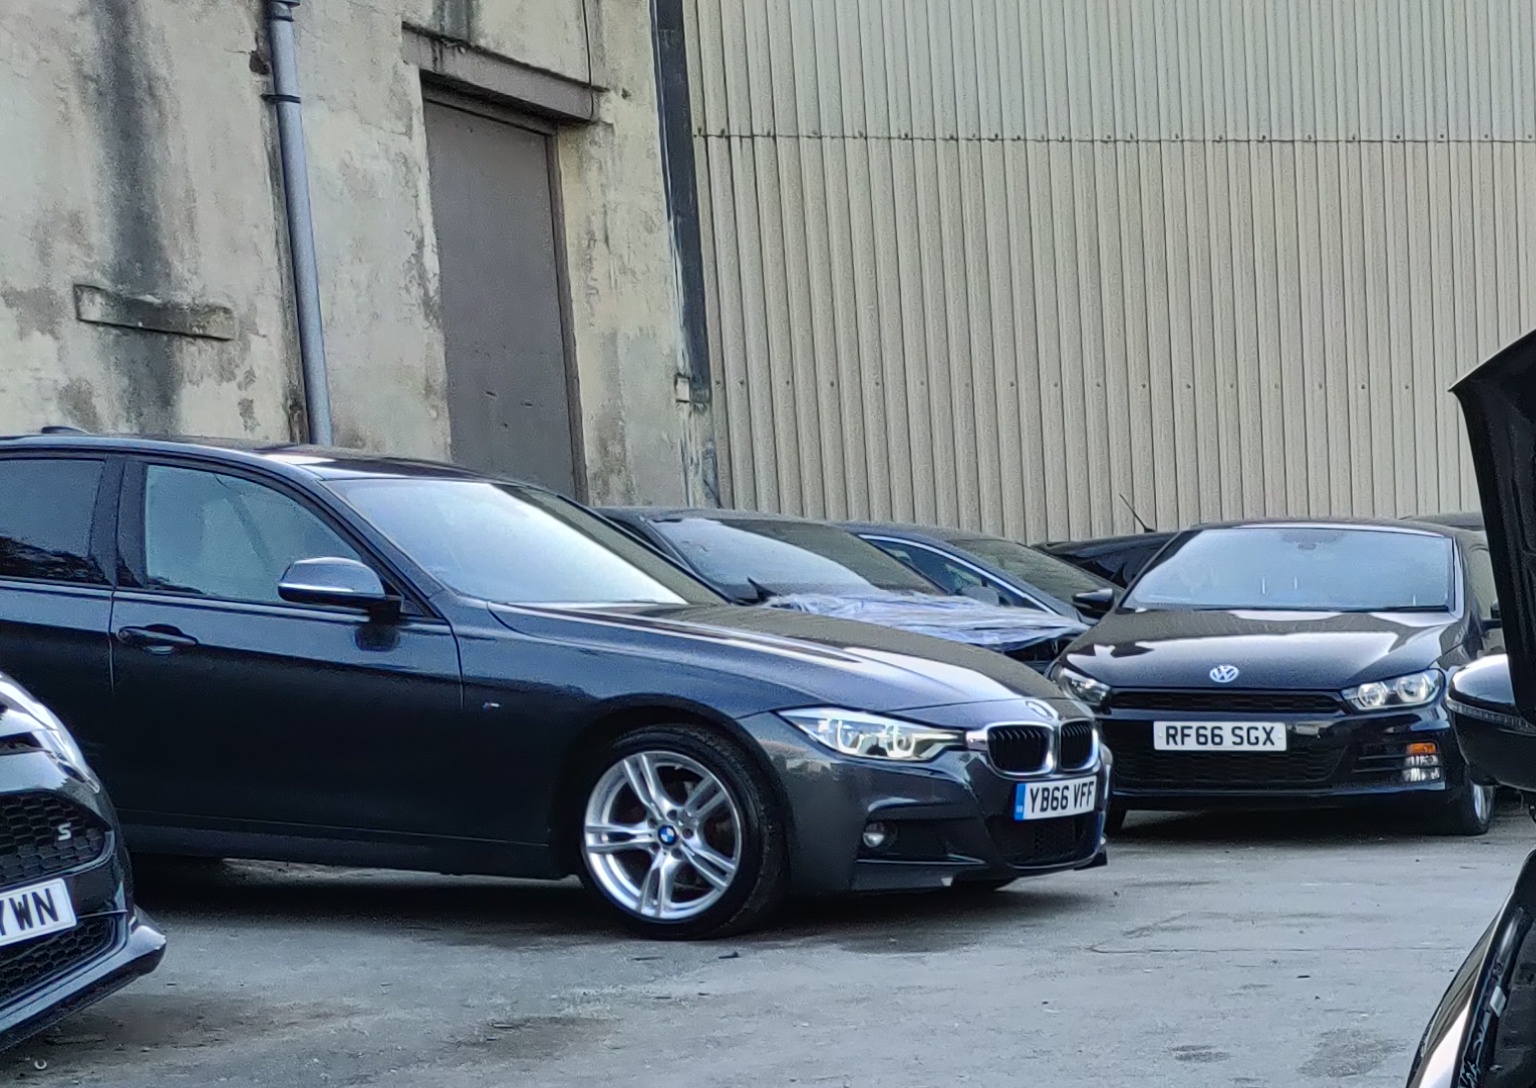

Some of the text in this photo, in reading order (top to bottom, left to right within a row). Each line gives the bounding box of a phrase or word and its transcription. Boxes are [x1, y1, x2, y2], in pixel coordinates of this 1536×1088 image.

[1165, 725, 1276, 746] RF66 SGX
[1029, 780, 1095, 813] YB66 VFF
